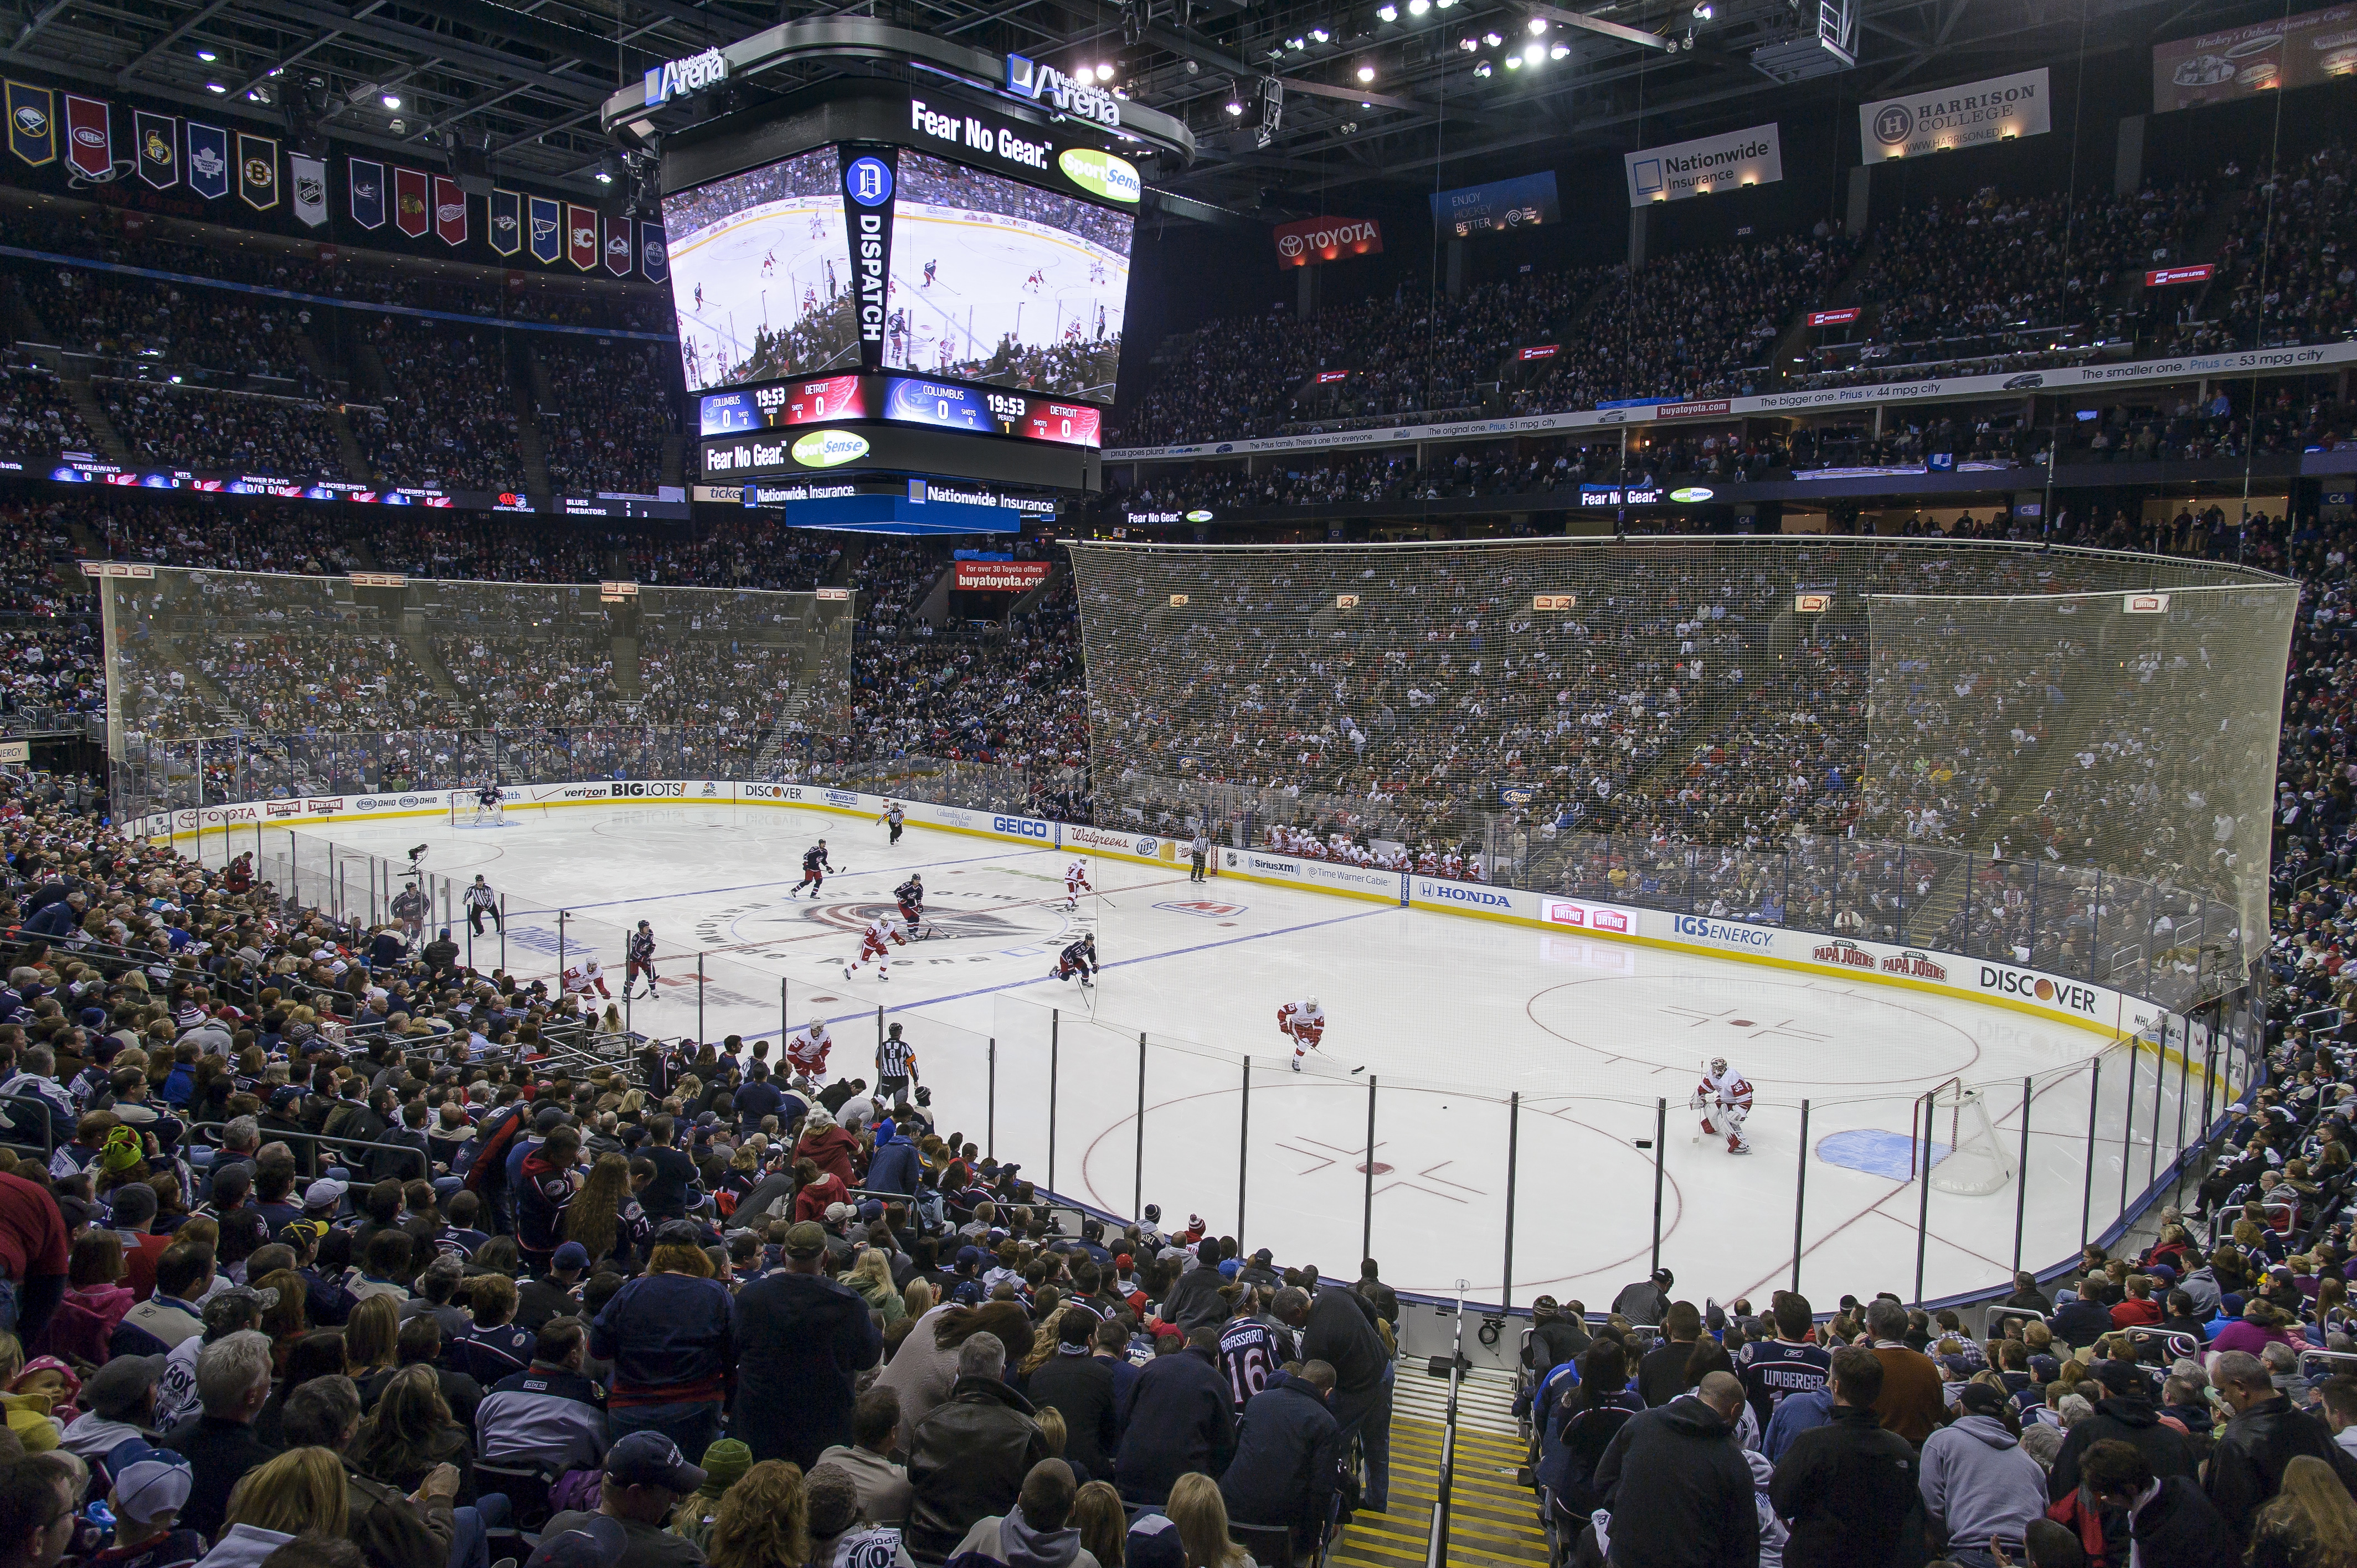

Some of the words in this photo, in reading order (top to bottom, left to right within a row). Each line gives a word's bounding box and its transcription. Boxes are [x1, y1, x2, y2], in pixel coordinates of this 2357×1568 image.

[678, 46, 719, 72] Nationwide
[660, 55, 724, 101] Arena
[1056, 71, 1110, 101] Nationwide
[1030, 65, 1120, 126] Arena
[1918, 85, 2036, 118] HARRISON
[1919, 104, 2014, 132] COLLEGE
[912, 100, 961, 142] Fear
[966, 117, 994, 152] No
[999, 129, 1047, 169] Gear.
[1902, 126, 2008, 153] WWW.HARRISON.EDU
[1665, 141, 1769, 174] Nationwide
[1668, 169, 1733, 190] Insurance
[302, 187, 318, 199] NHL
[1452, 192, 1481, 207] ENJOY
[1454, 204, 1491, 220] HOCKEY
[1456, 218, 1491, 233] BETTER
[1305, 222, 1377, 250] TOYOTA
[860, 214, 882, 341] DISPATCH
[2082, 369, 2103, 380] The
[2106, 363, 2153, 378] smaller
[2156, 364, 2185, 373] one.
[2190, 359, 2220, 370] Prius
[2224, 359, 2236, 368] c.
[2240, 355, 2256, 366] 53
[2260, 353, 2293, 365] mpg
[2297, 350, 2325, 362] city
[713, 395, 740, 408] COLUMBUS
[755, 387, 785, 407] 19:53
[805, 383, 829, 395] DETROIT
[923, 385, 964, 400] COLUMBUS
[987, 394, 1025, 416] 19:53
[1050, 405, 1078, 418] DETROIT
[1761, 398, 1777, 407] The
[1779, 396, 1812, 406] bigger
[1814, 393, 1836, 402] one.
[1840, 390, 1862, 400] Prius
[1866, 389, 1874, 398] v.
[1877, 388, 1890, 396] 44
[1892, 385, 1918, 396] mpg
[1921, 383, 1941, 394] city
[722, 410, 731, 428] 0
[768, 414, 774, 426] 1
[797, 411, 801, 419] 0
[815, 396, 824, 416] 0
[937, 400, 949, 420] 0
[961, 408, 976, 417] SHOTS
[997, 414, 1015, 422] PERIOD
[1661, 403, 1727, 416] buyatoyota.com
[968, 416, 974, 425] 0
[1003, 421, 1010, 434] 1
[1033, 419, 1047, 427] SHOTS
[1061, 419, 1072, 437] 0
[1429, 427, 1441, 435] The
[1443, 424, 1470, 436] original
[1489, 422, 1507, 431] Prius.
[1520, 421, 1538, 430] mpg
[1542, 418, 1557, 427] city
[1296, 437, 1317, 446] There's
[1342, 434, 1374, 443] everyone.
[707, 449, 733, 470] Fear
[735, 446, 751, 468] No
[754, 444, 784, 467] Gear.
[1110, 449, 1126, 458] prius
[1127, 449, 1144, 458] goes
[1145, 447, 1165, 457] plural
[72, 463, 121, 473] TAKEAWAYS
[84, 472, 92, 481] 0
[107, 474, 115, 483] 0
[172, 479, 179, 487] 0
[194, 480, 202, 489] 0
[241, 476, 267, 484] POWER
[246, 484, 265, 494] 0/0
[267, 485, 285, 495] 0/0
[326, 490, 332, 498] 0
[353, 492, 359, 501] 0
[757, 486, 807, 502] Nationwide
[810, 484, 854, 498] Insurance
[1582, 493, 1607, 506] Fear
[1628, 491, 1658, 503] Gear.
[2329, 494, 2345, 503] C6
[928, 486, 996, 506] Nationwide
[1001, 494, 1054, 512] Insurance
[1128, 513, 1147, 523] Fear
[1148, 513, 1159, 522] No
[1161, 513, 1179, 522] Gear.
[2021, 505, 2034, 515] C5
[1002, 565, 1022, 574] Toyota
[564, 787, 607, 798] verizon
[745, 785, 802, 799] DISCOVER
[831, 792, 848, 801] NEWS
[201, 807, 257, 823] TOYOTA
[936, 808, 960, 819] Columbia
[955, 818, 969, 827] Ohio
[994, 817, 1047, 838] GEICO
[1071, 828, 1129, 848] Walgreens
[1318, 868, 1336, 879] Time
[1337, 871, 1364, 883] Warner
[1366, 875, 1388, 886] Cable
[1436, 886, 1511, 908] HONDA
[1554, 908, 1582, 922] ORTHO
[1596, 914, 1625, 929] ORTHO
[1687, 936, 1710, 946] POWER
[1723, 943, 1765, 954] TOMORROW
[1814, 947, 1839, 962] PAPA
[1841, 948, 1875, 968] JOHNS
[1883, 958, 1909, 973] PAPA
[1911, 960, 1946, 980] JOHNS
[1981, 966, 2096, 1014] DISCOVER
[791, 1038, 801, 1048] 55
[1733, 1082, 1744, 1092] 35
[1221, 1329, 1263, 1354] BRASSARD
[167, 1364, 197, 1397] FOX
[1227, 1348, 1268, 1404] 16
[1763, 1369, 1824, 1390] UMBERGER
